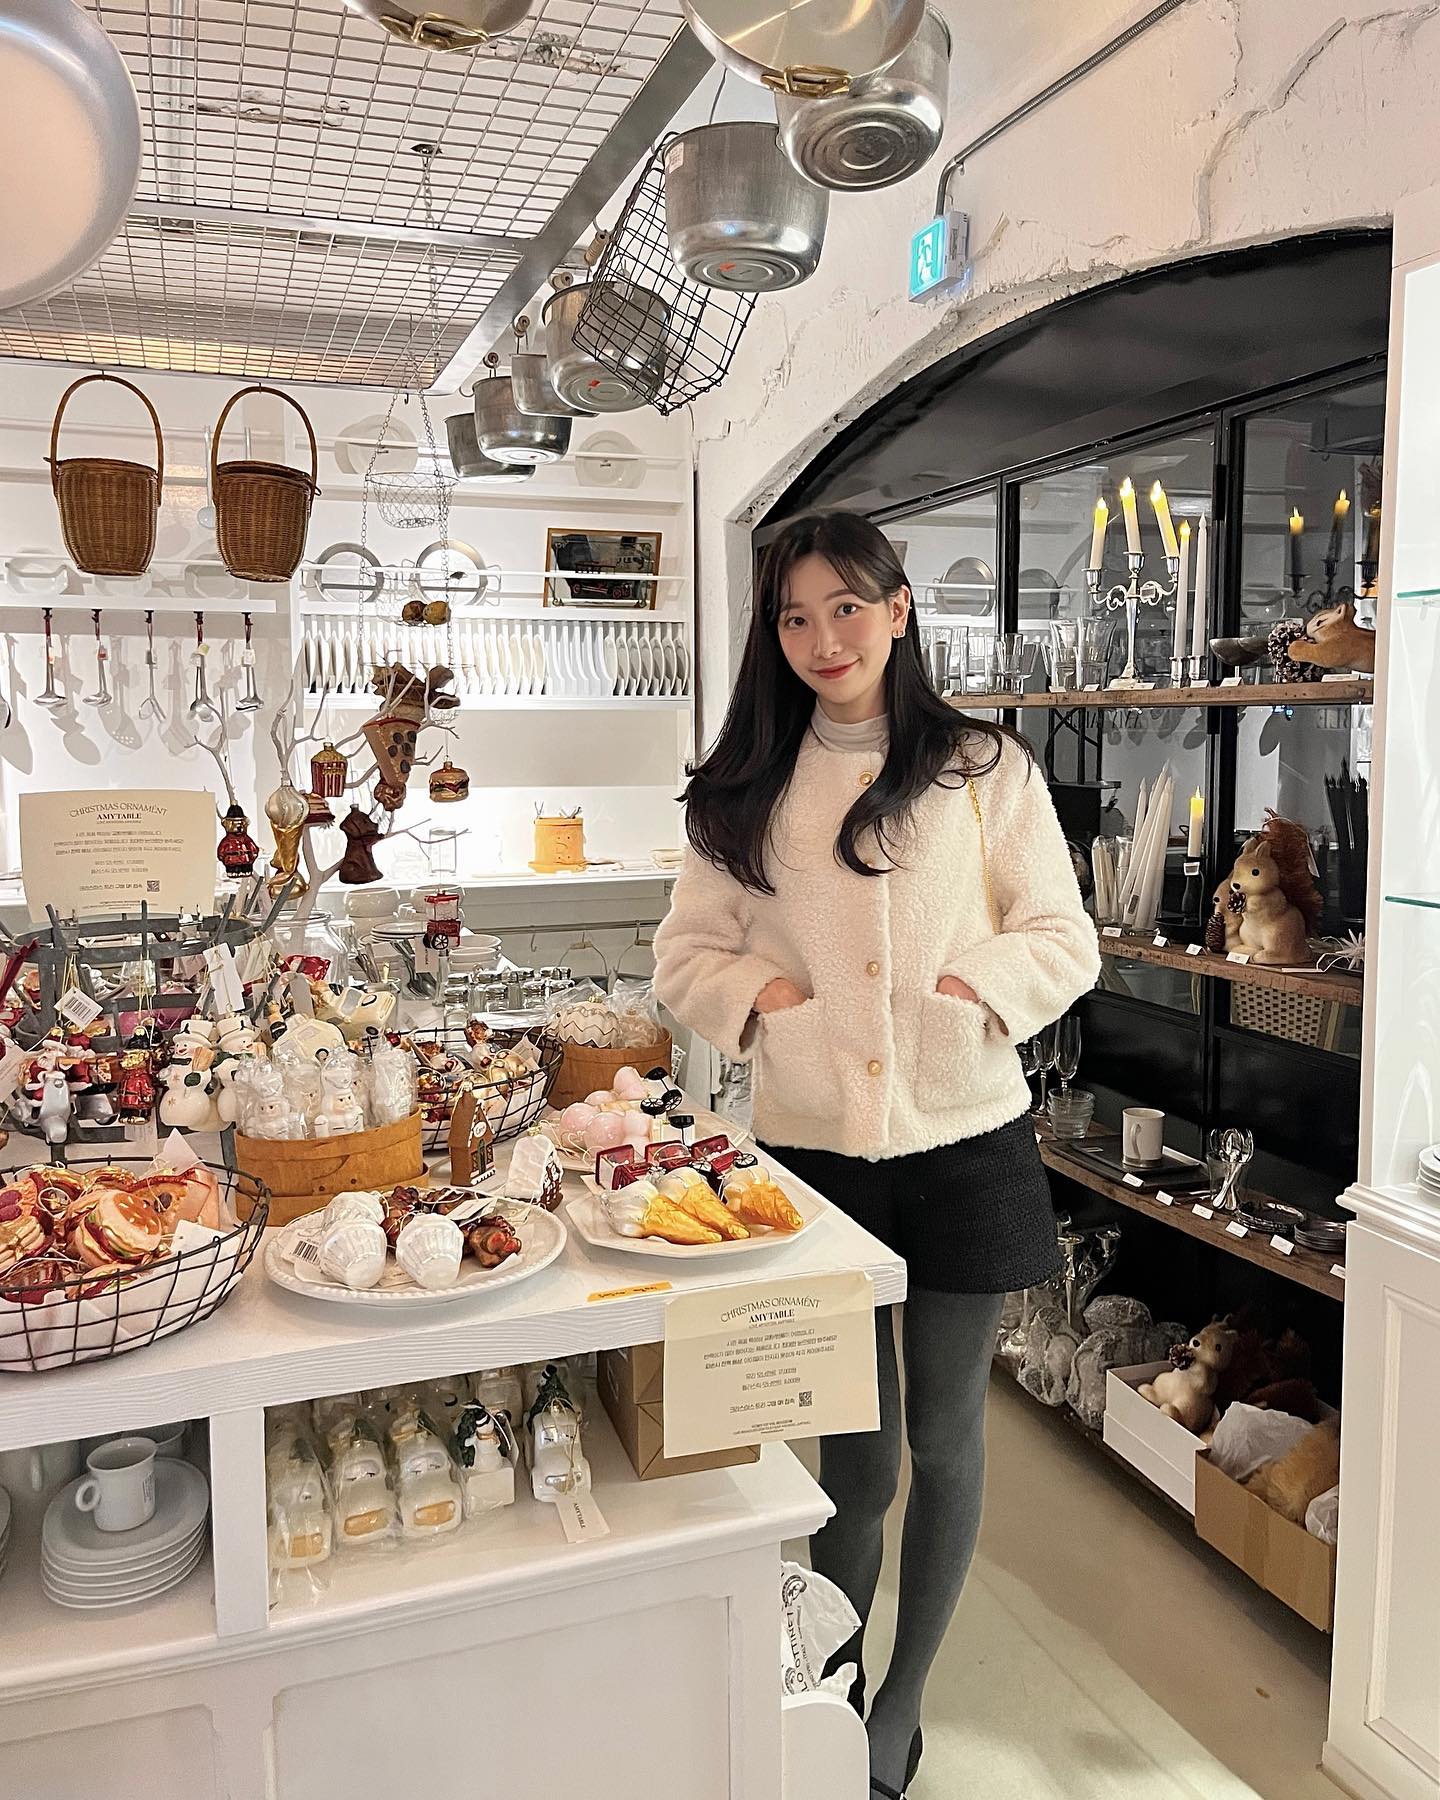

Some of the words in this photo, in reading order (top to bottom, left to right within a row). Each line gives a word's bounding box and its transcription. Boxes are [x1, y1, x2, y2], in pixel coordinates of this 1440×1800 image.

[69, 802, 118, 818] CHRISTMAS
[96, 812, 142, 820] AMYTABLE
[720, 1298, 770, 1323] CHRISTMAS
[749, 1308, 795, 1323] AMYTABLE
